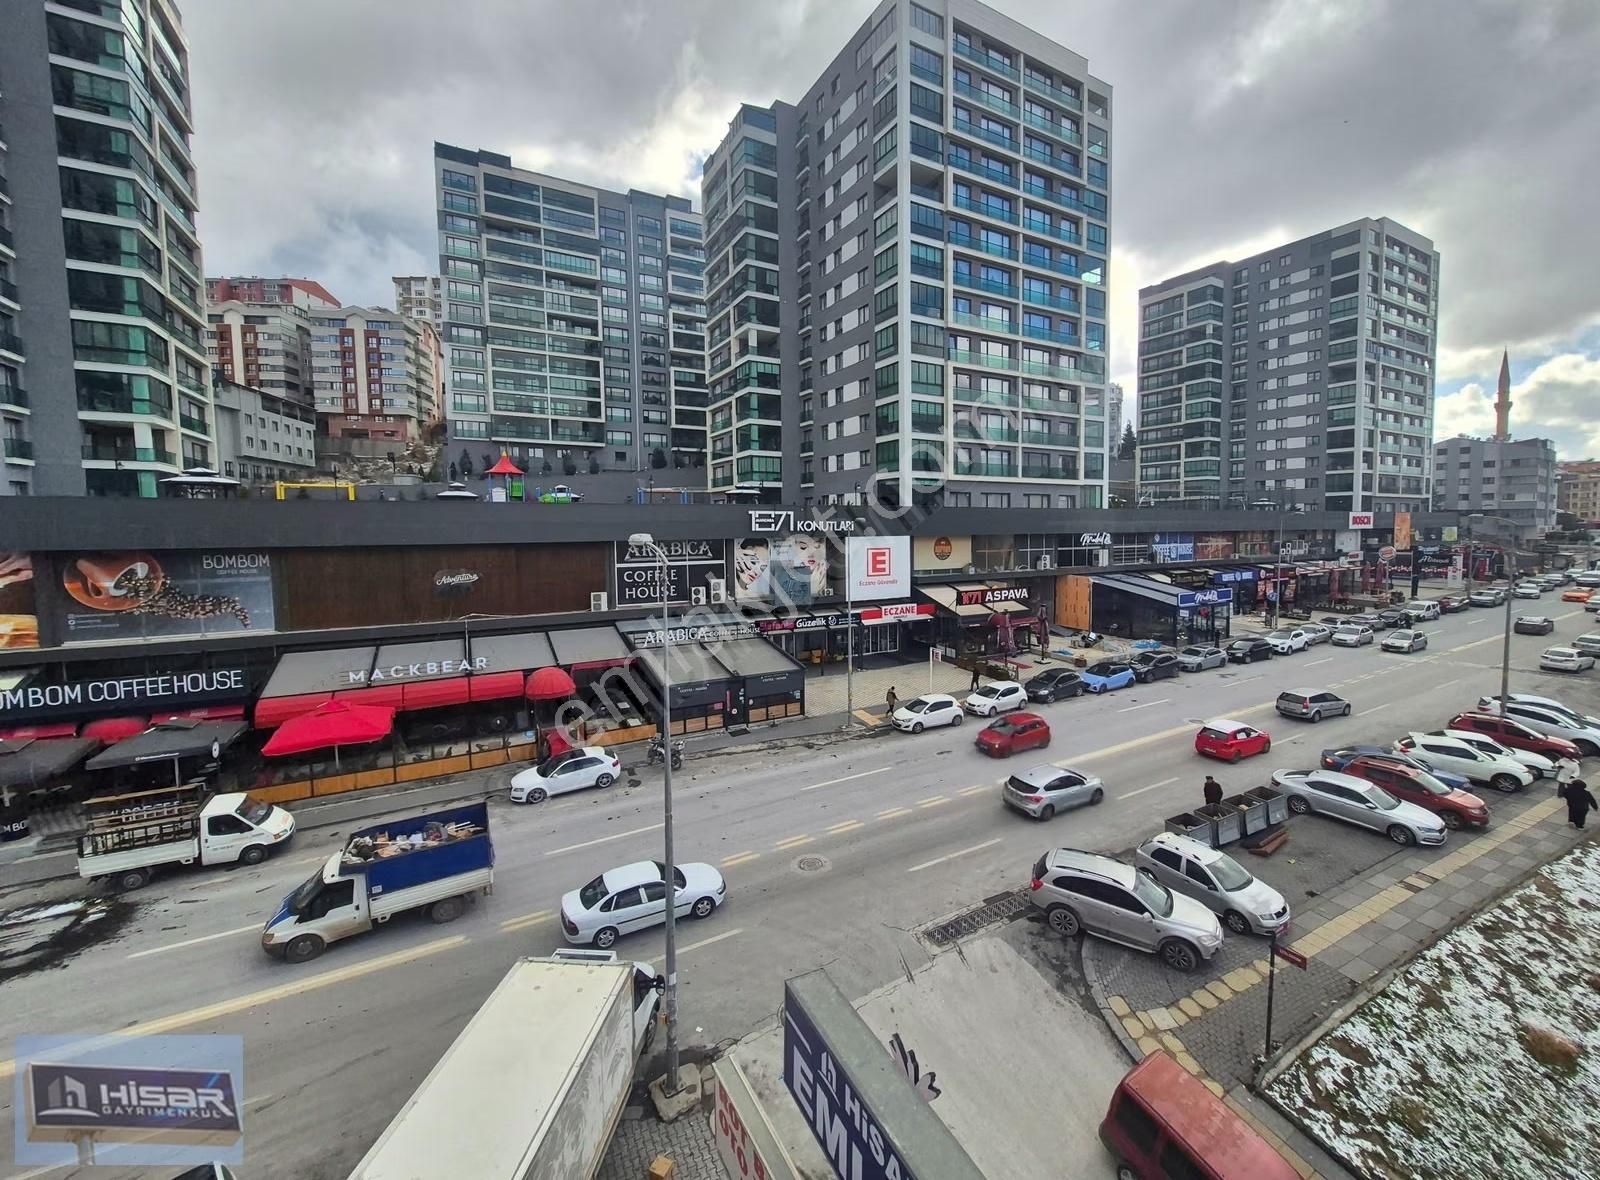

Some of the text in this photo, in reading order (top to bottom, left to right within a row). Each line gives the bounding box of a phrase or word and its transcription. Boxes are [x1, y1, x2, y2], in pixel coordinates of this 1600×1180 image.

[624, 541, 713, 561] ARABICA
[203, 554, 270, 569] BOMBOM
[624, 569, 678, 582] COFFE
[625, 585, 678, 599] HOUSE
[985, 588, 1029, 602] ASPAVA
[884, 605, 916, 616] ECZANE
[796, 616, 827, 628] Güzellik
[643, 626, 708, 648] ARABICA
[349, 657, 488, 683] MACKBEAR
[0, 670, 244, 710] M BOM COFFEE HOUSE
